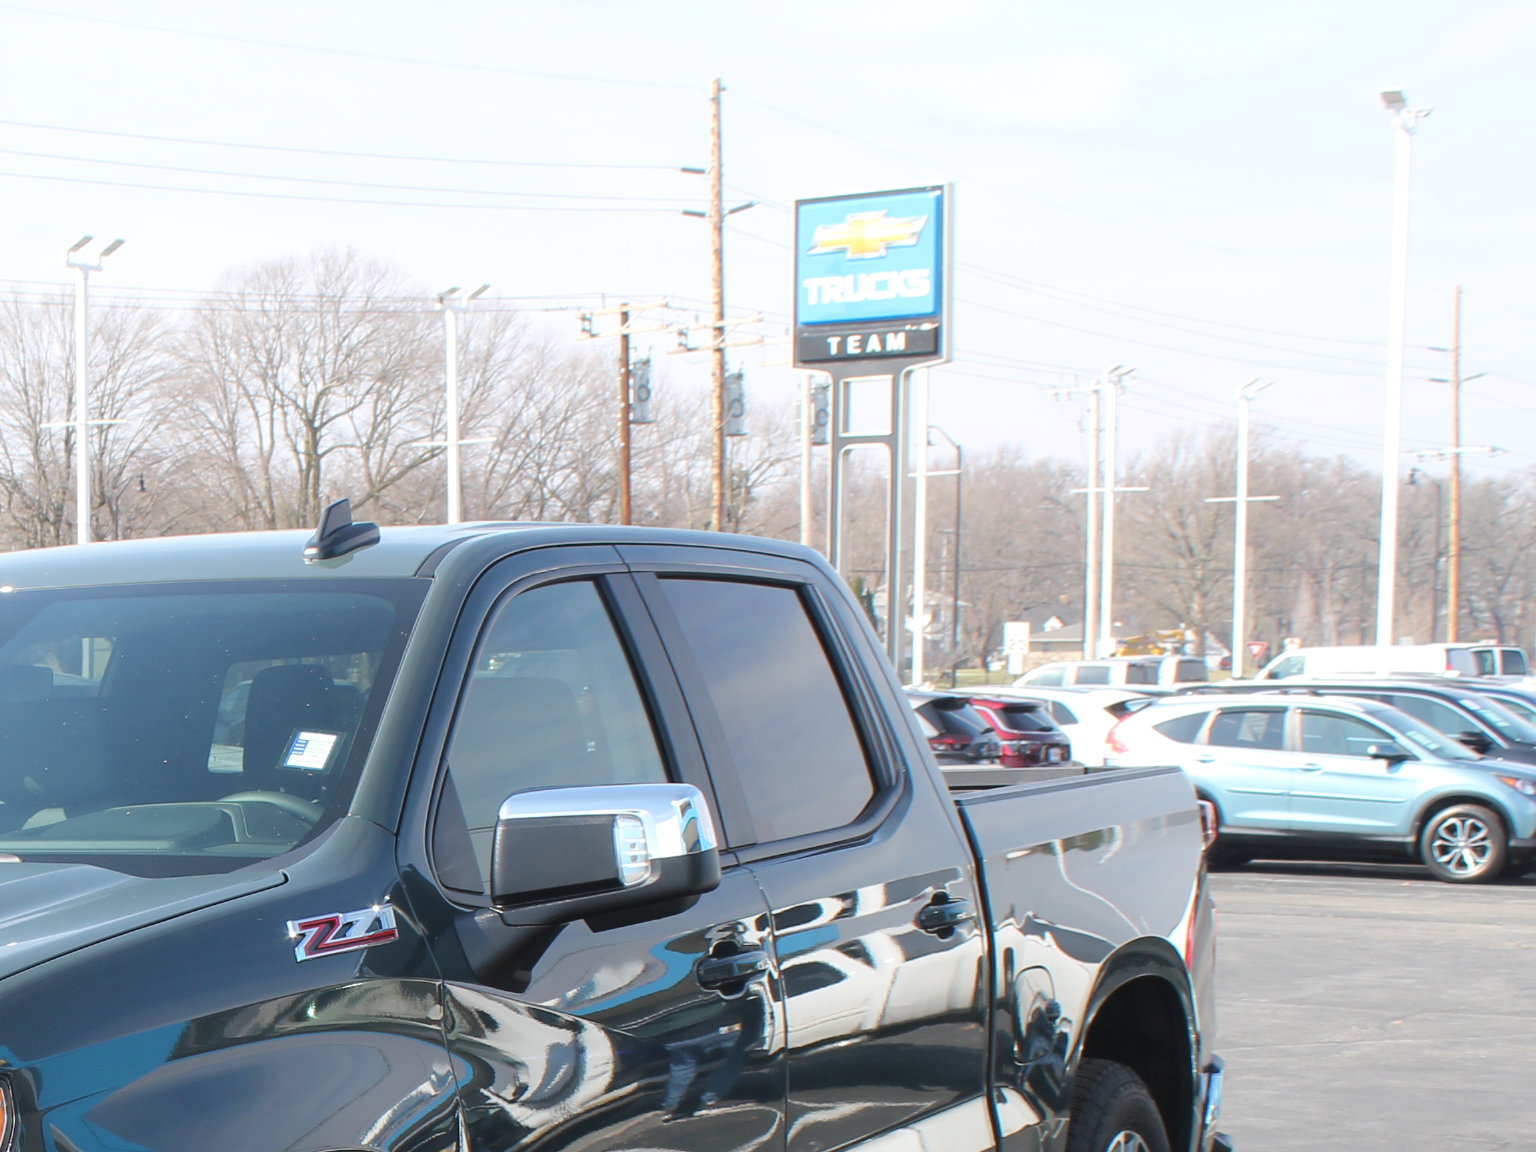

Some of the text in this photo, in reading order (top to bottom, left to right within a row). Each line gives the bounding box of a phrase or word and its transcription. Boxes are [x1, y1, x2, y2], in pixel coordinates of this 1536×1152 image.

[802, 268, 931, 306] TRUCKS
[826, 332, 907, 356] TEAM
[286, 903, 400, 963] Z71
